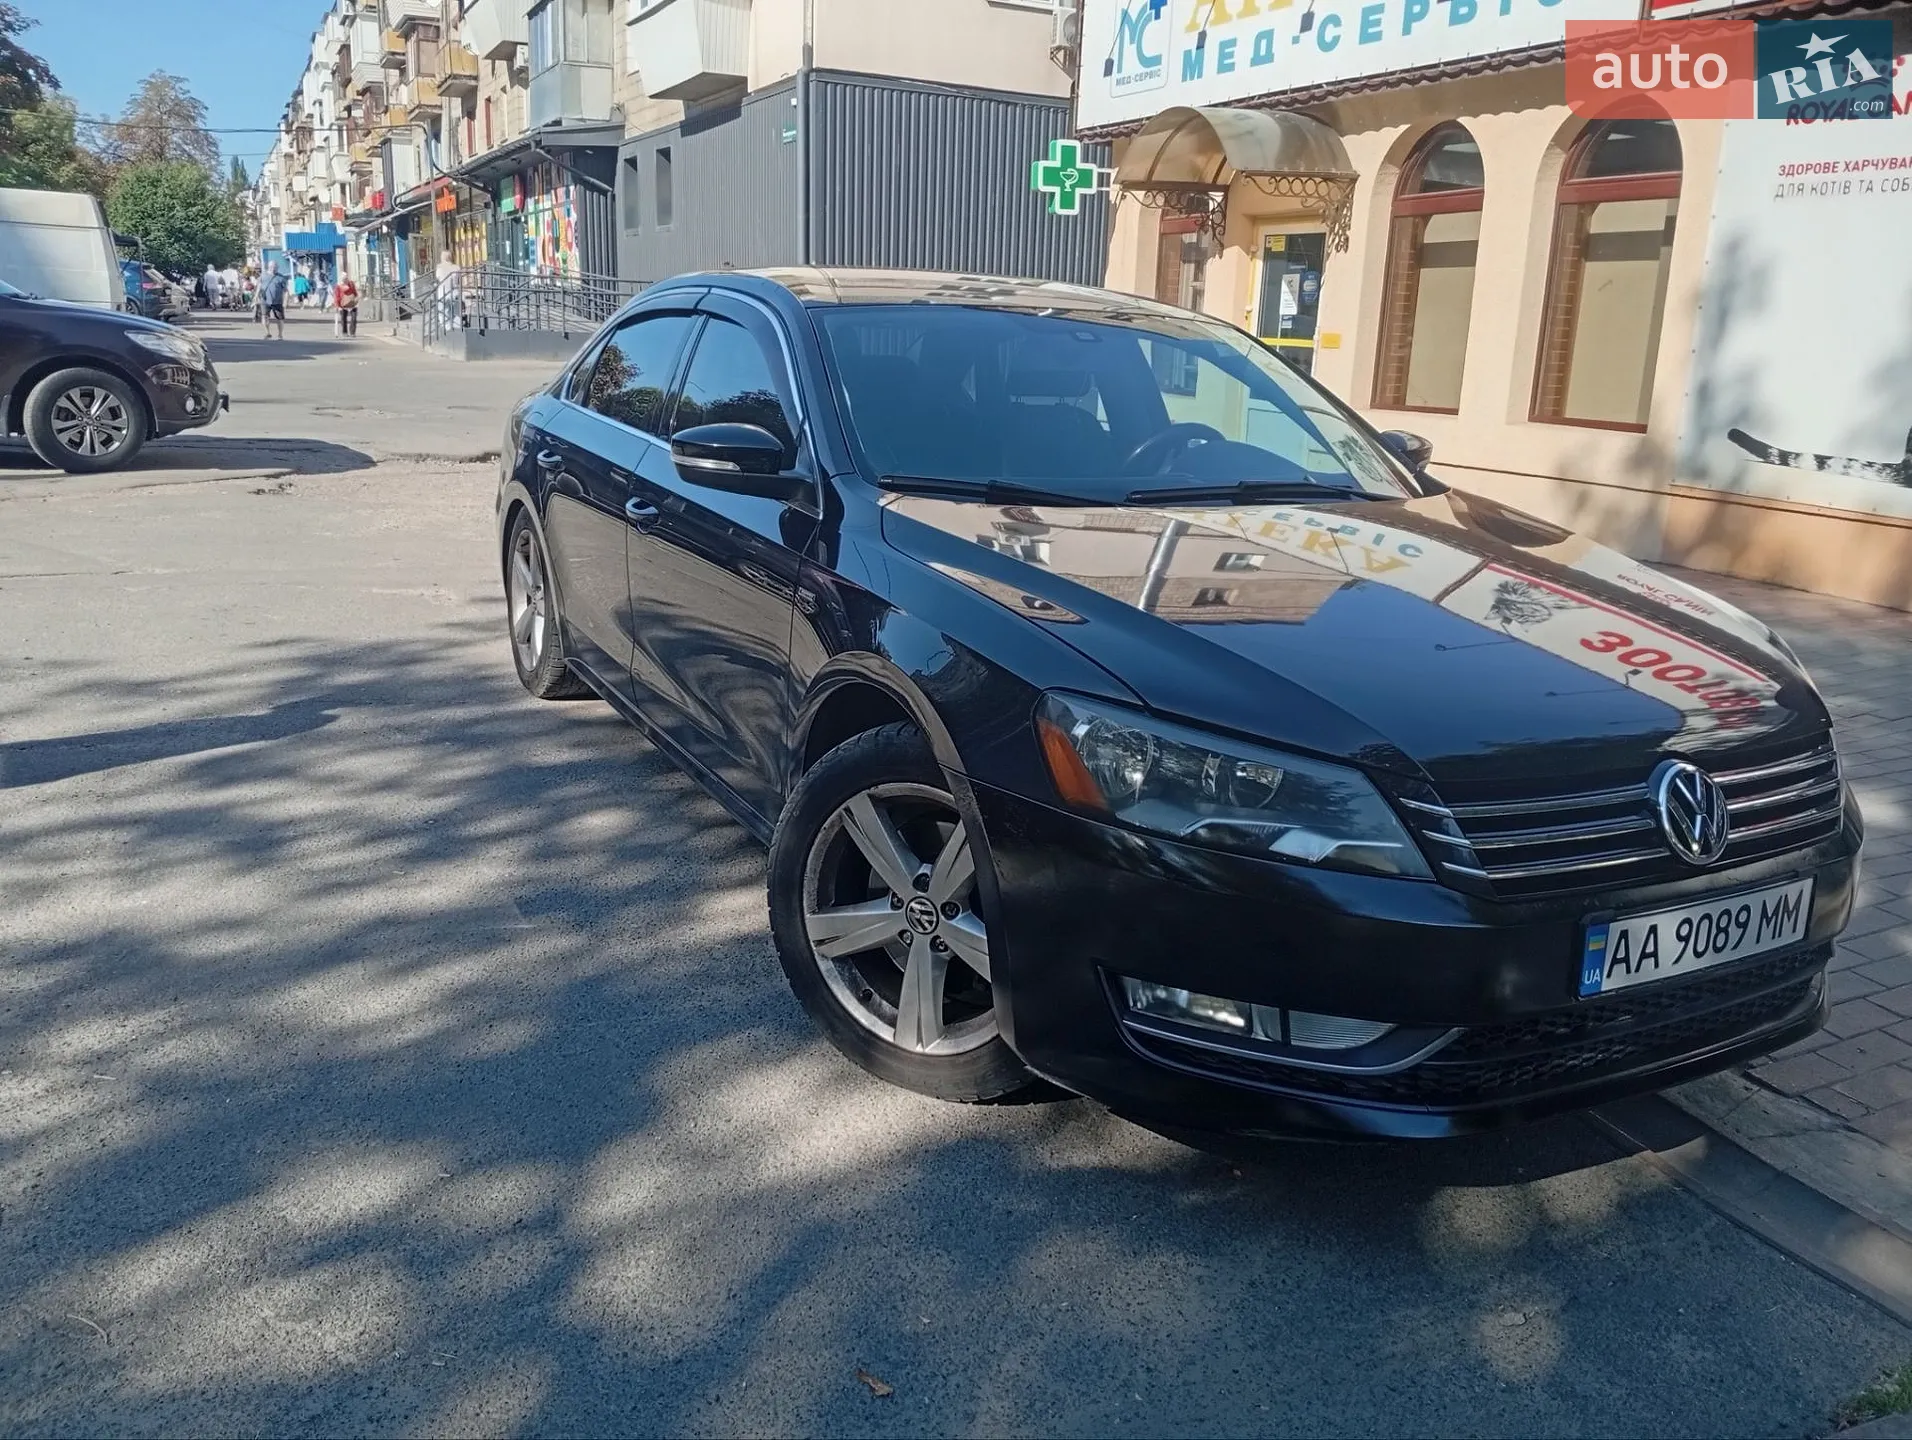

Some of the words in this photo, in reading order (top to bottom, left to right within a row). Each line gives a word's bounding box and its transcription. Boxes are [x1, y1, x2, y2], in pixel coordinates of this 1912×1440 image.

[1778, 161, 1840, 177] ЗДОРОВЕ
[1774, 183, 1805, 201] ДЛЯ
[1810, 180, 1852, 196] КОТІВ
[1859, 179, 1874, 194] ТА
[1881, 176, 1912, 193] СОБ
[1606, 923, 1660, 979] AA
[1672, 903, 1752, 966] 9089
[1755, 888, 1804, 945] MM
[1584, 969, 1601, 985] UA
